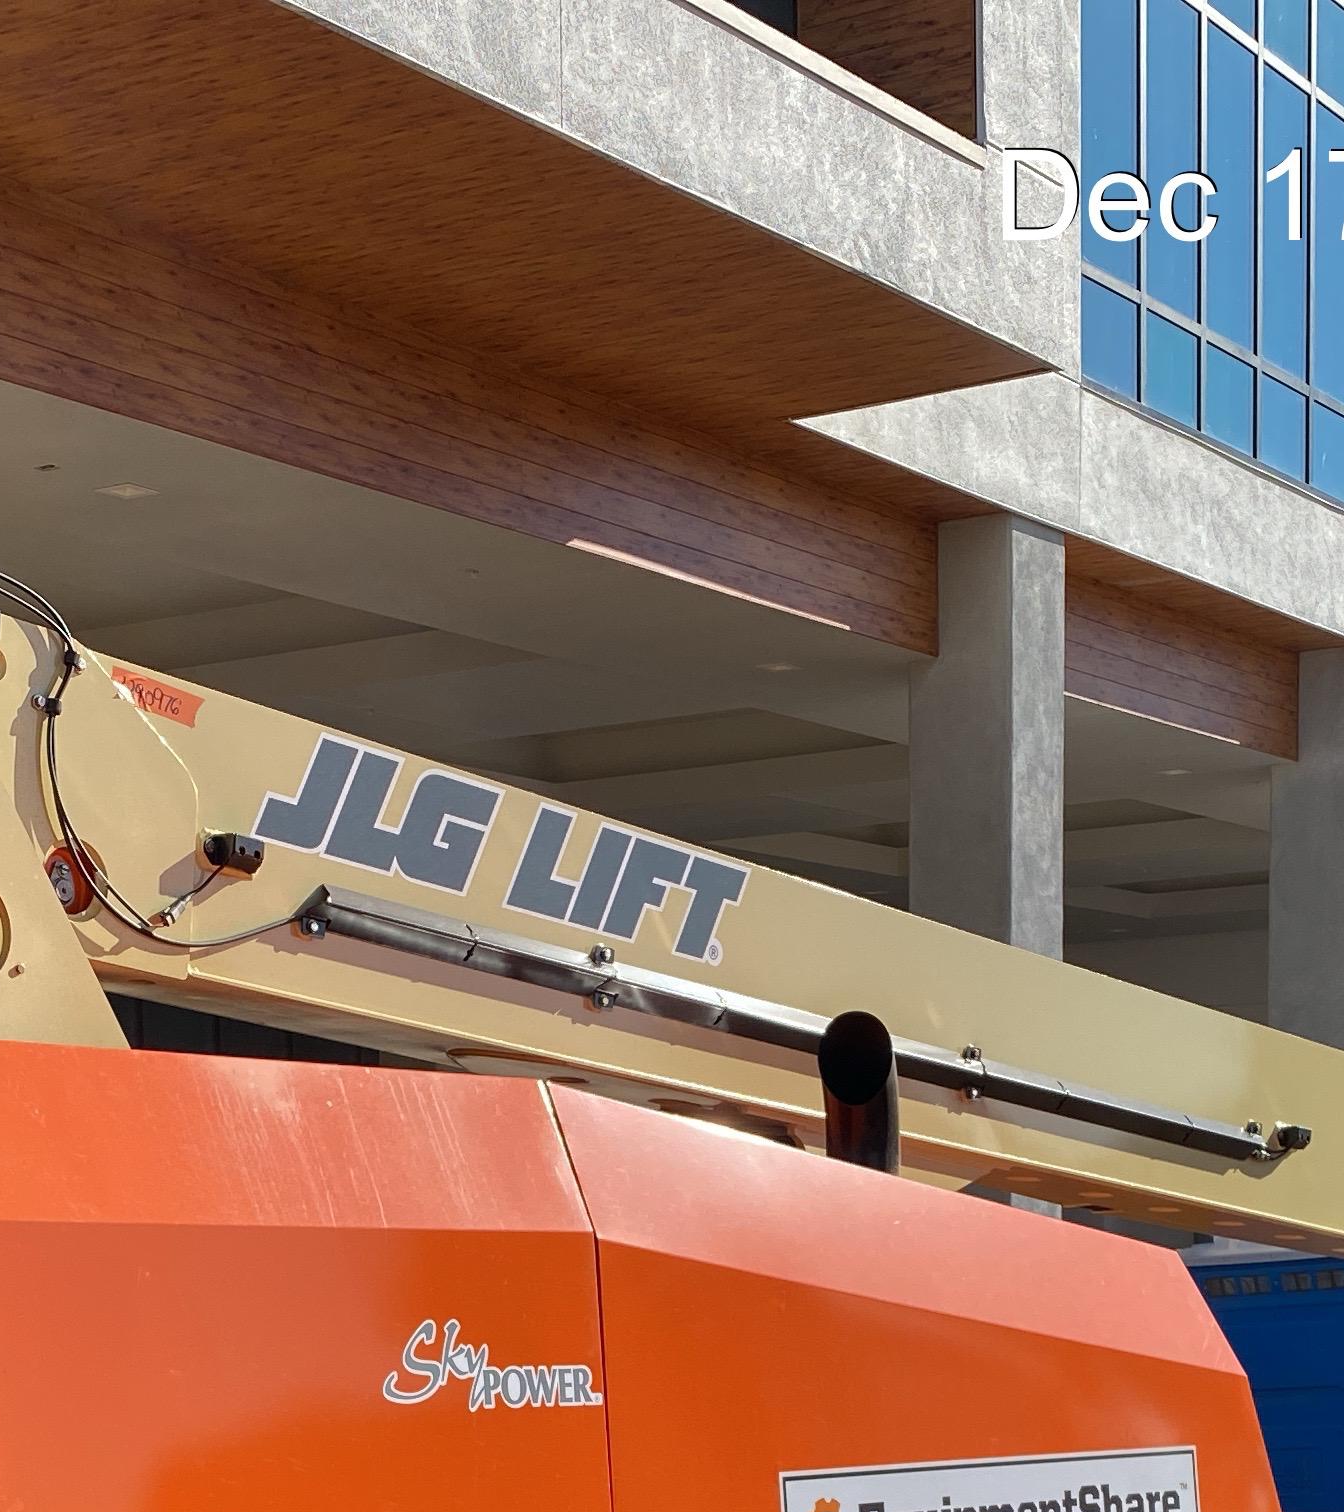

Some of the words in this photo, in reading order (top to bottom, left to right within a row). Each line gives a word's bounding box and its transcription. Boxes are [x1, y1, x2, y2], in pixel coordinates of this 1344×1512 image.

[252, 732, 506, 896] JLG
[502, 801, 752, 962] LIFT
[383, 1318, 488, 1412] Sky
[484, 1365, 594, 1409] POWER
